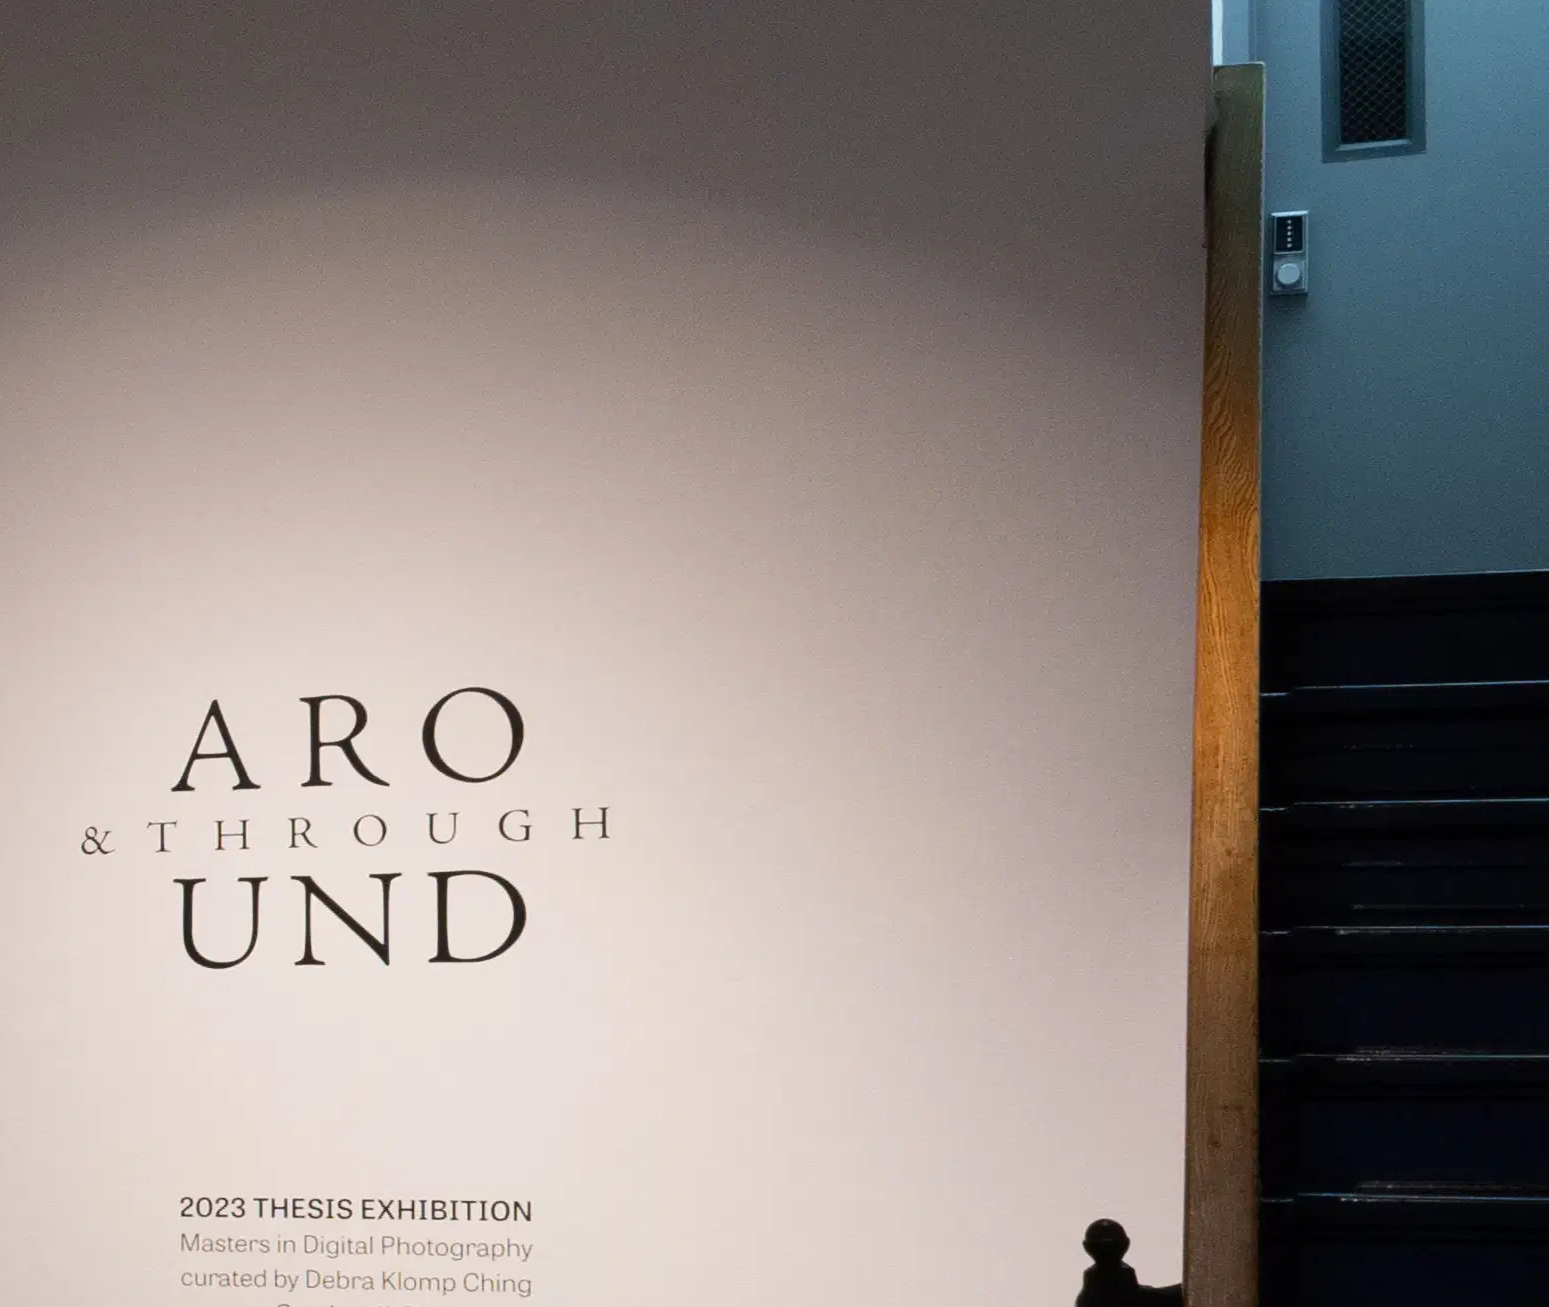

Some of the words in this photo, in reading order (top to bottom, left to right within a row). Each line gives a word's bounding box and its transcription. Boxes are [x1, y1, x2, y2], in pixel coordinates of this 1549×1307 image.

[171, 687, 524, 792] ARO
[81, 825, 115, 855] &
[147, 806, 610, 853] THROUGH
[173, 870, 527, 969] UND
[180, 1197, 246, 1218] 2023
[253, 1197, 353, 1220] THESIS
[361, 1199, 533, 1222] EXHIBITION
[180, 1233, 271, 1254] Masters
[276, 1234, 296, 1254] in
[303, 1235, 374, 1259] Digital
[381, 1236, 533, 1262] Photography
[180, 1269, 267, 1288] curated
[274, 1270, 299, 1292] by
[306, 1270, 375, 1291] Debra
[382, 1271, 456, 1296] Klomp
[463, 1272, 533, 1298] Ching
